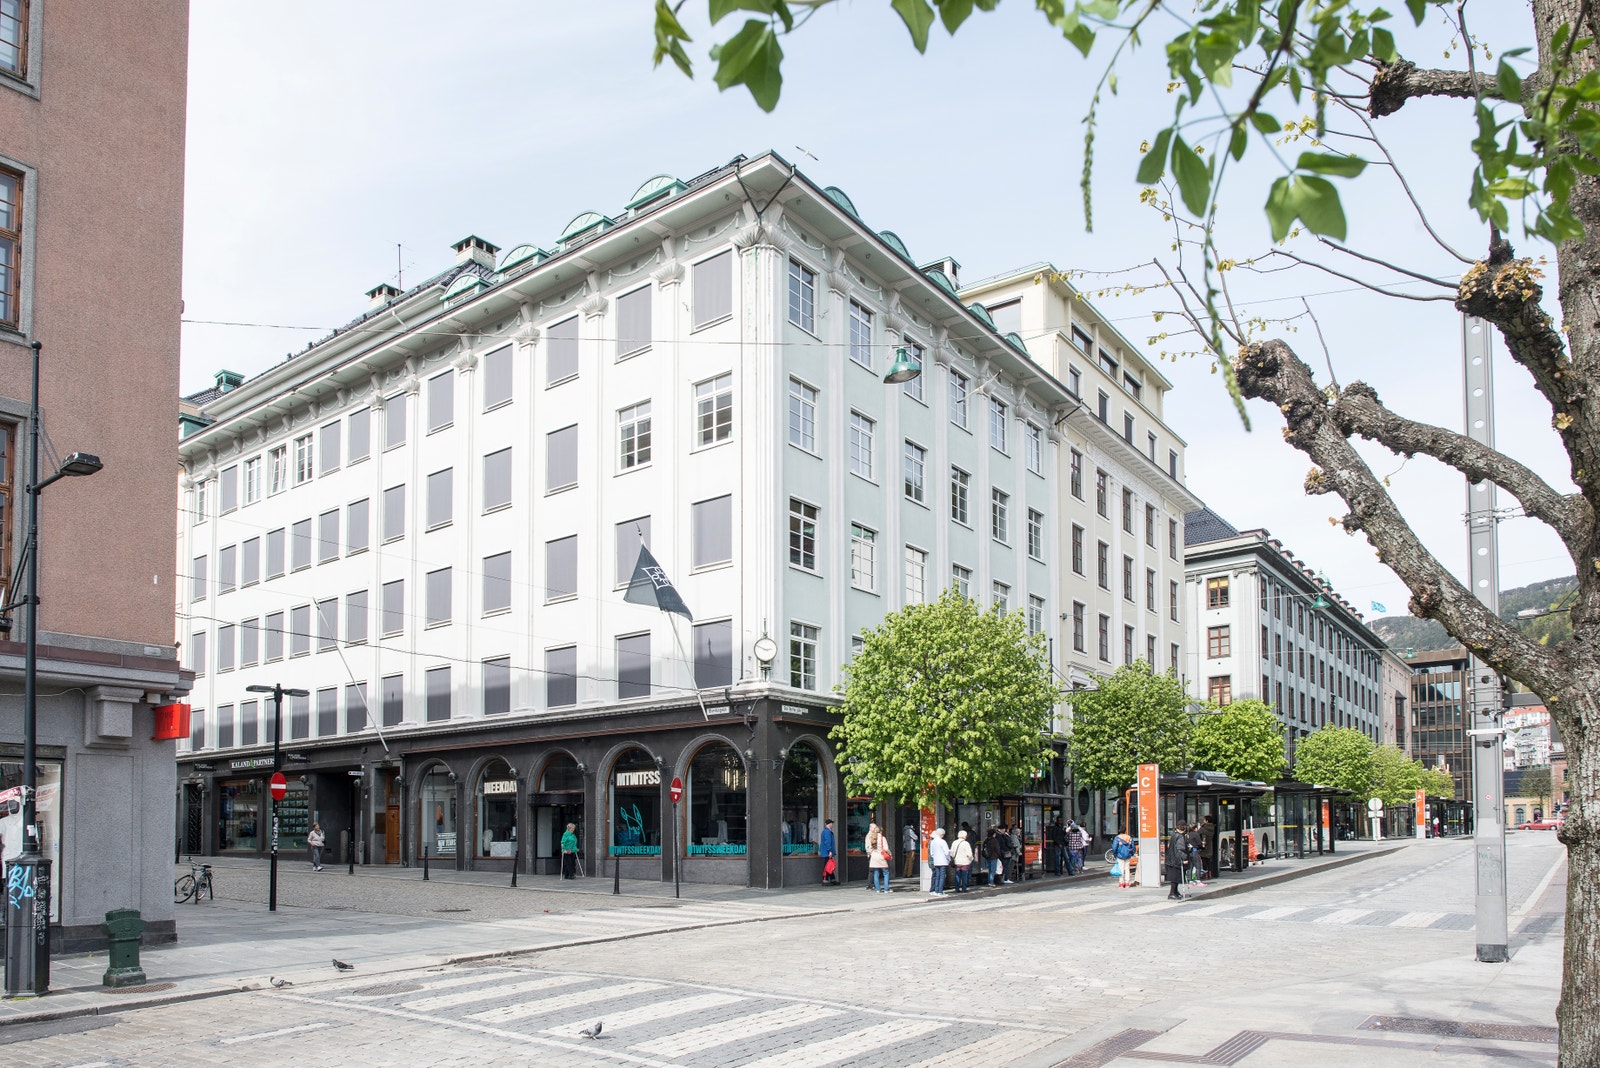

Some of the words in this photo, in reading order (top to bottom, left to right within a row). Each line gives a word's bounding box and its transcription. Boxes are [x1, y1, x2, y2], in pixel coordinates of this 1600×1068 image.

[616, 770, 661, 786] MTWTFSS
[1141, 777, 1150, 787] C
[484, 780, 518, 794] WEEKDAY
[985, 811, 992, 819] D
